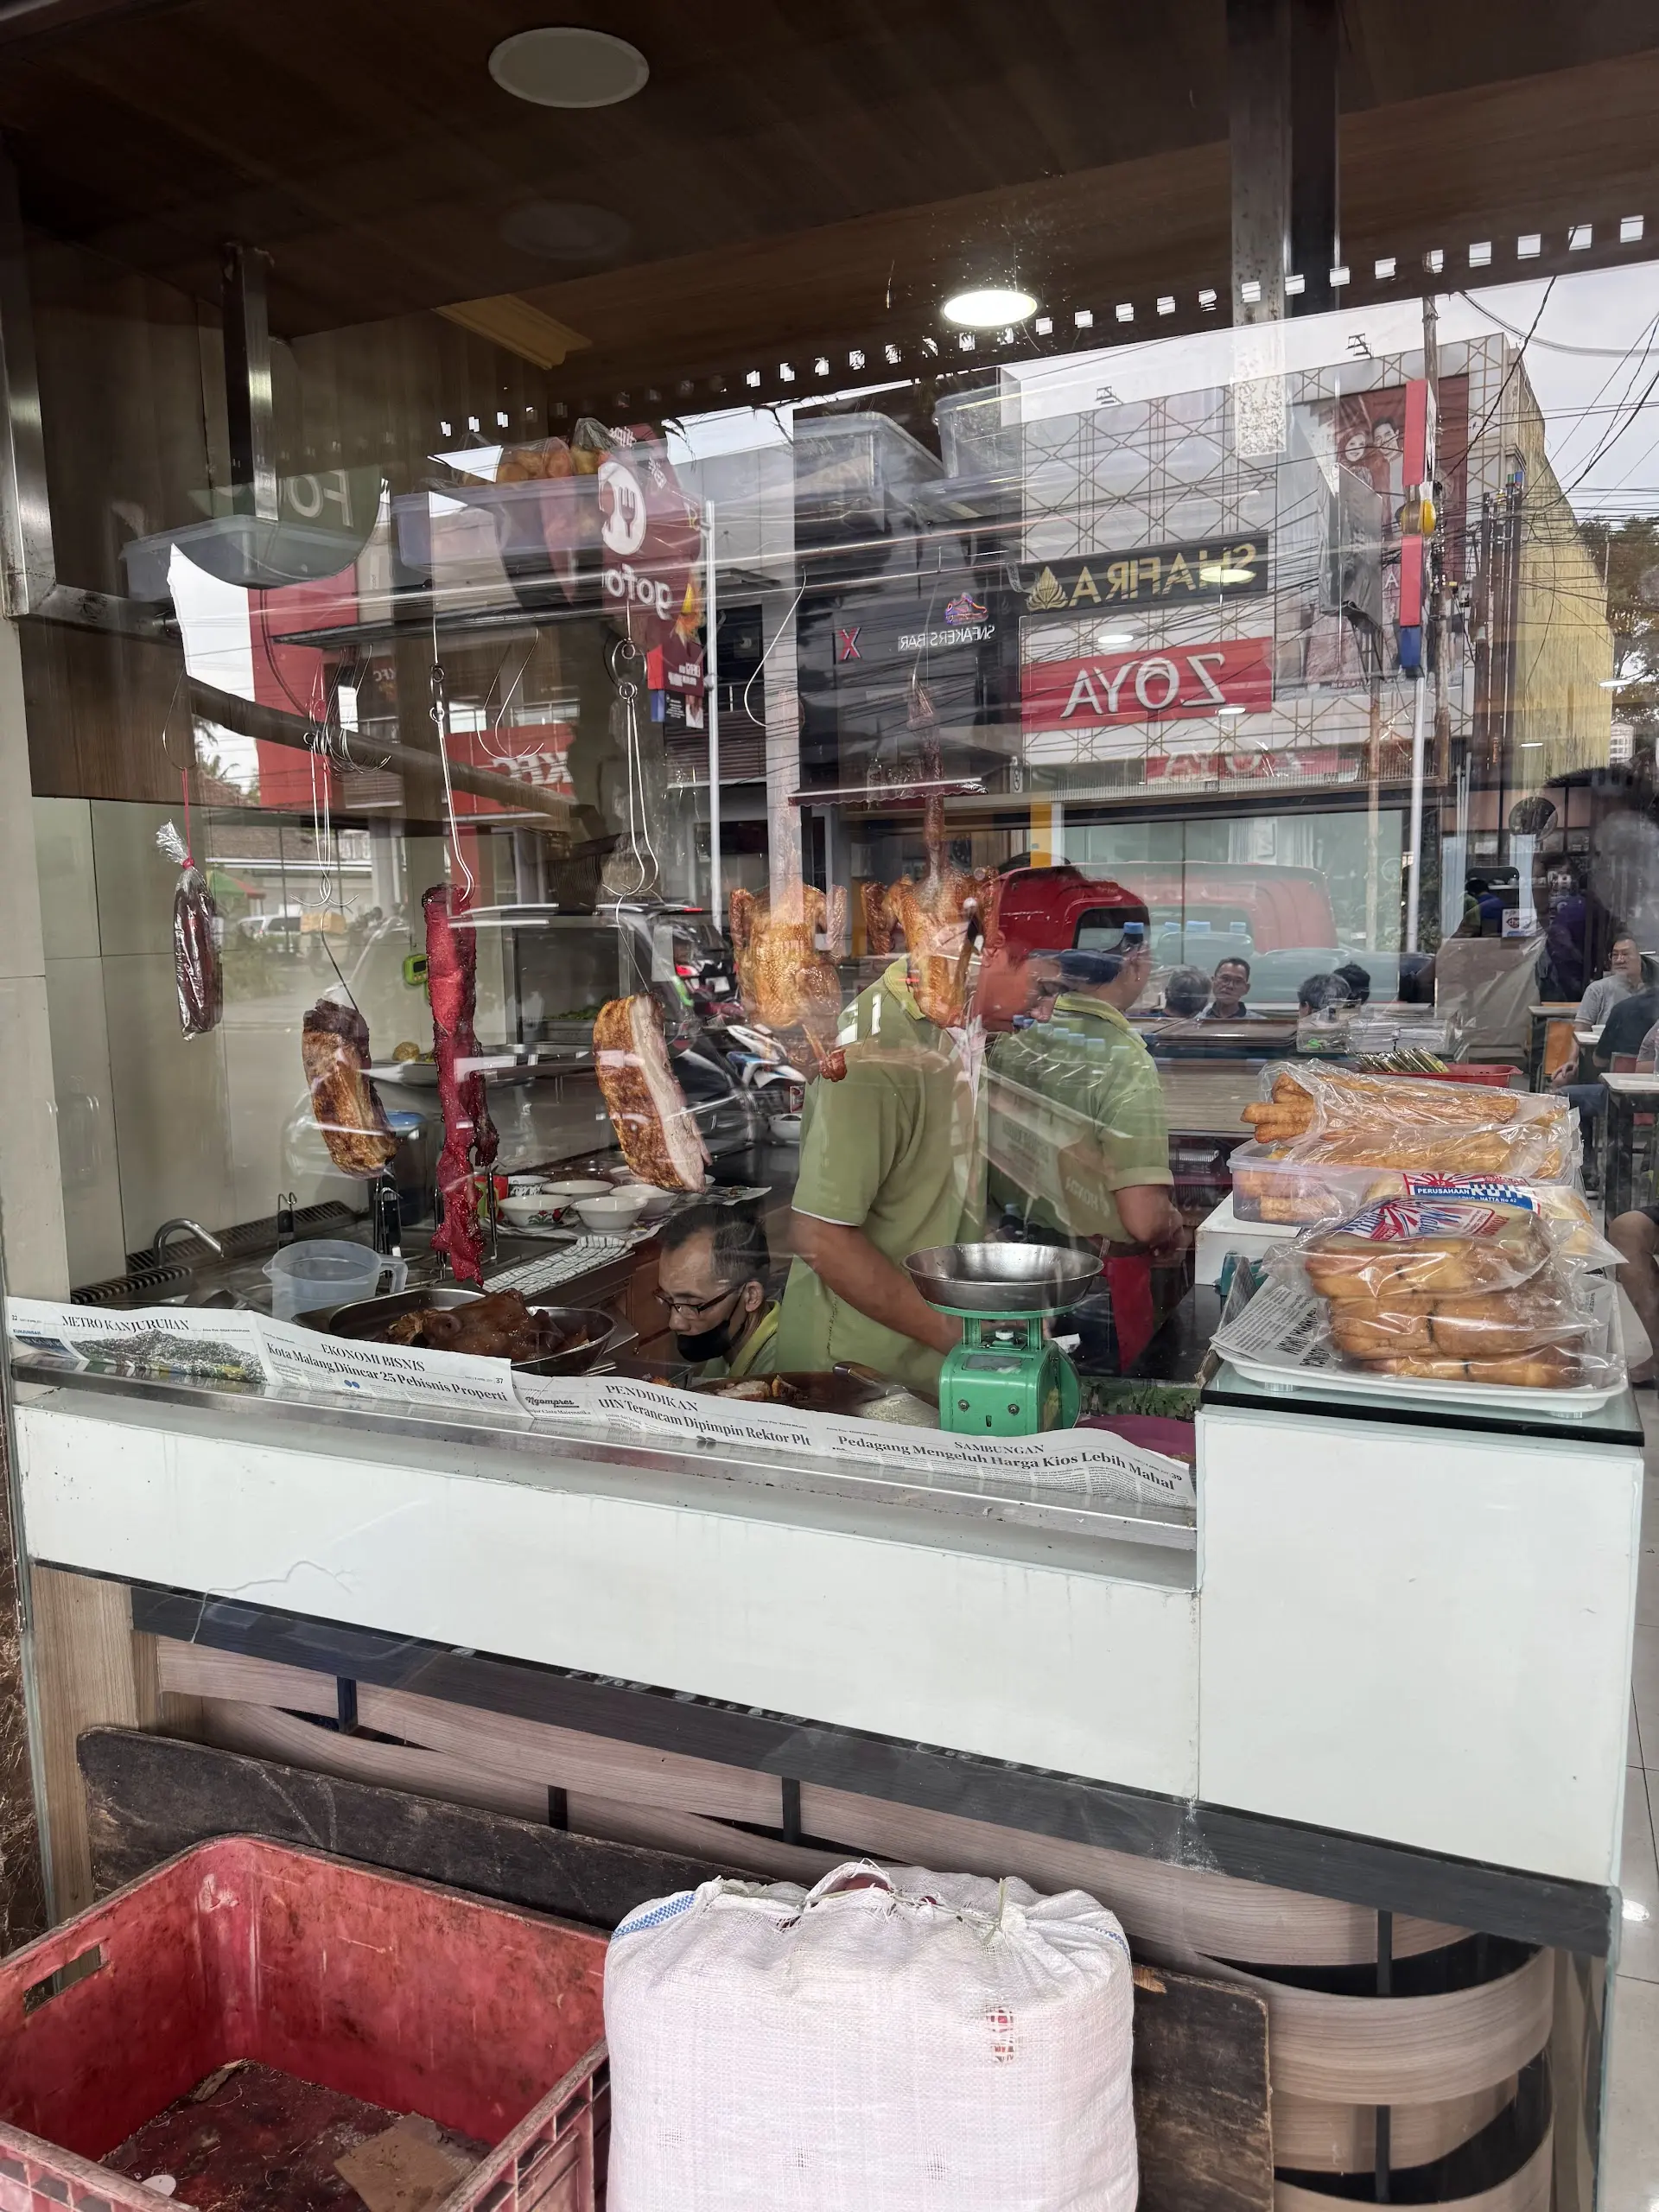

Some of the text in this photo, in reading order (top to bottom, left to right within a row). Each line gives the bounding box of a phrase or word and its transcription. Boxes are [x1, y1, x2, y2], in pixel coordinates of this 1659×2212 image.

[62, 1315, 190, 1332] METRO KANJURUHAN
[321, 1343, 425, 1372] EKONOMI BISNIS
[267, 1342, 292, 1360] Kota
[294, 1351, 335, 1374] Malang
[335, 1362, 379, 1380] Diincar
[382, 1370, 397, 1383] 25
[399, 1374, 452, 1393] Pebisnis
[454, 1383, 508, 1402] Properti
[525, 1396, 575, 1408] Ngompres
[605, 1385, 698, 1412] PENDIDIKAN
[598, 1399, 625, 1409] UIN
[625, 1400, 682, 1426] Terancam
[684, 1416, 744, 1437] Dipimpin
[746, 1427, 790, 1444] Rektor
[792, 1433, 812, 1446] Plt
[954, 1441, 1045, 1455] SAMBUNGAN
[838, 1435, 910, 1455] Pedagang
[912, 1445, 988, 1463] Mengeluh
[991, 1455, 1039, 1470] Harga
[1043, 1454, 1078, 1468] Kios
[1082, 1452, 1126, 1469] Lebih
[1128, 1461, 1175, 1491] Mahal
[1171, 1472, 1182, 1481] 39
